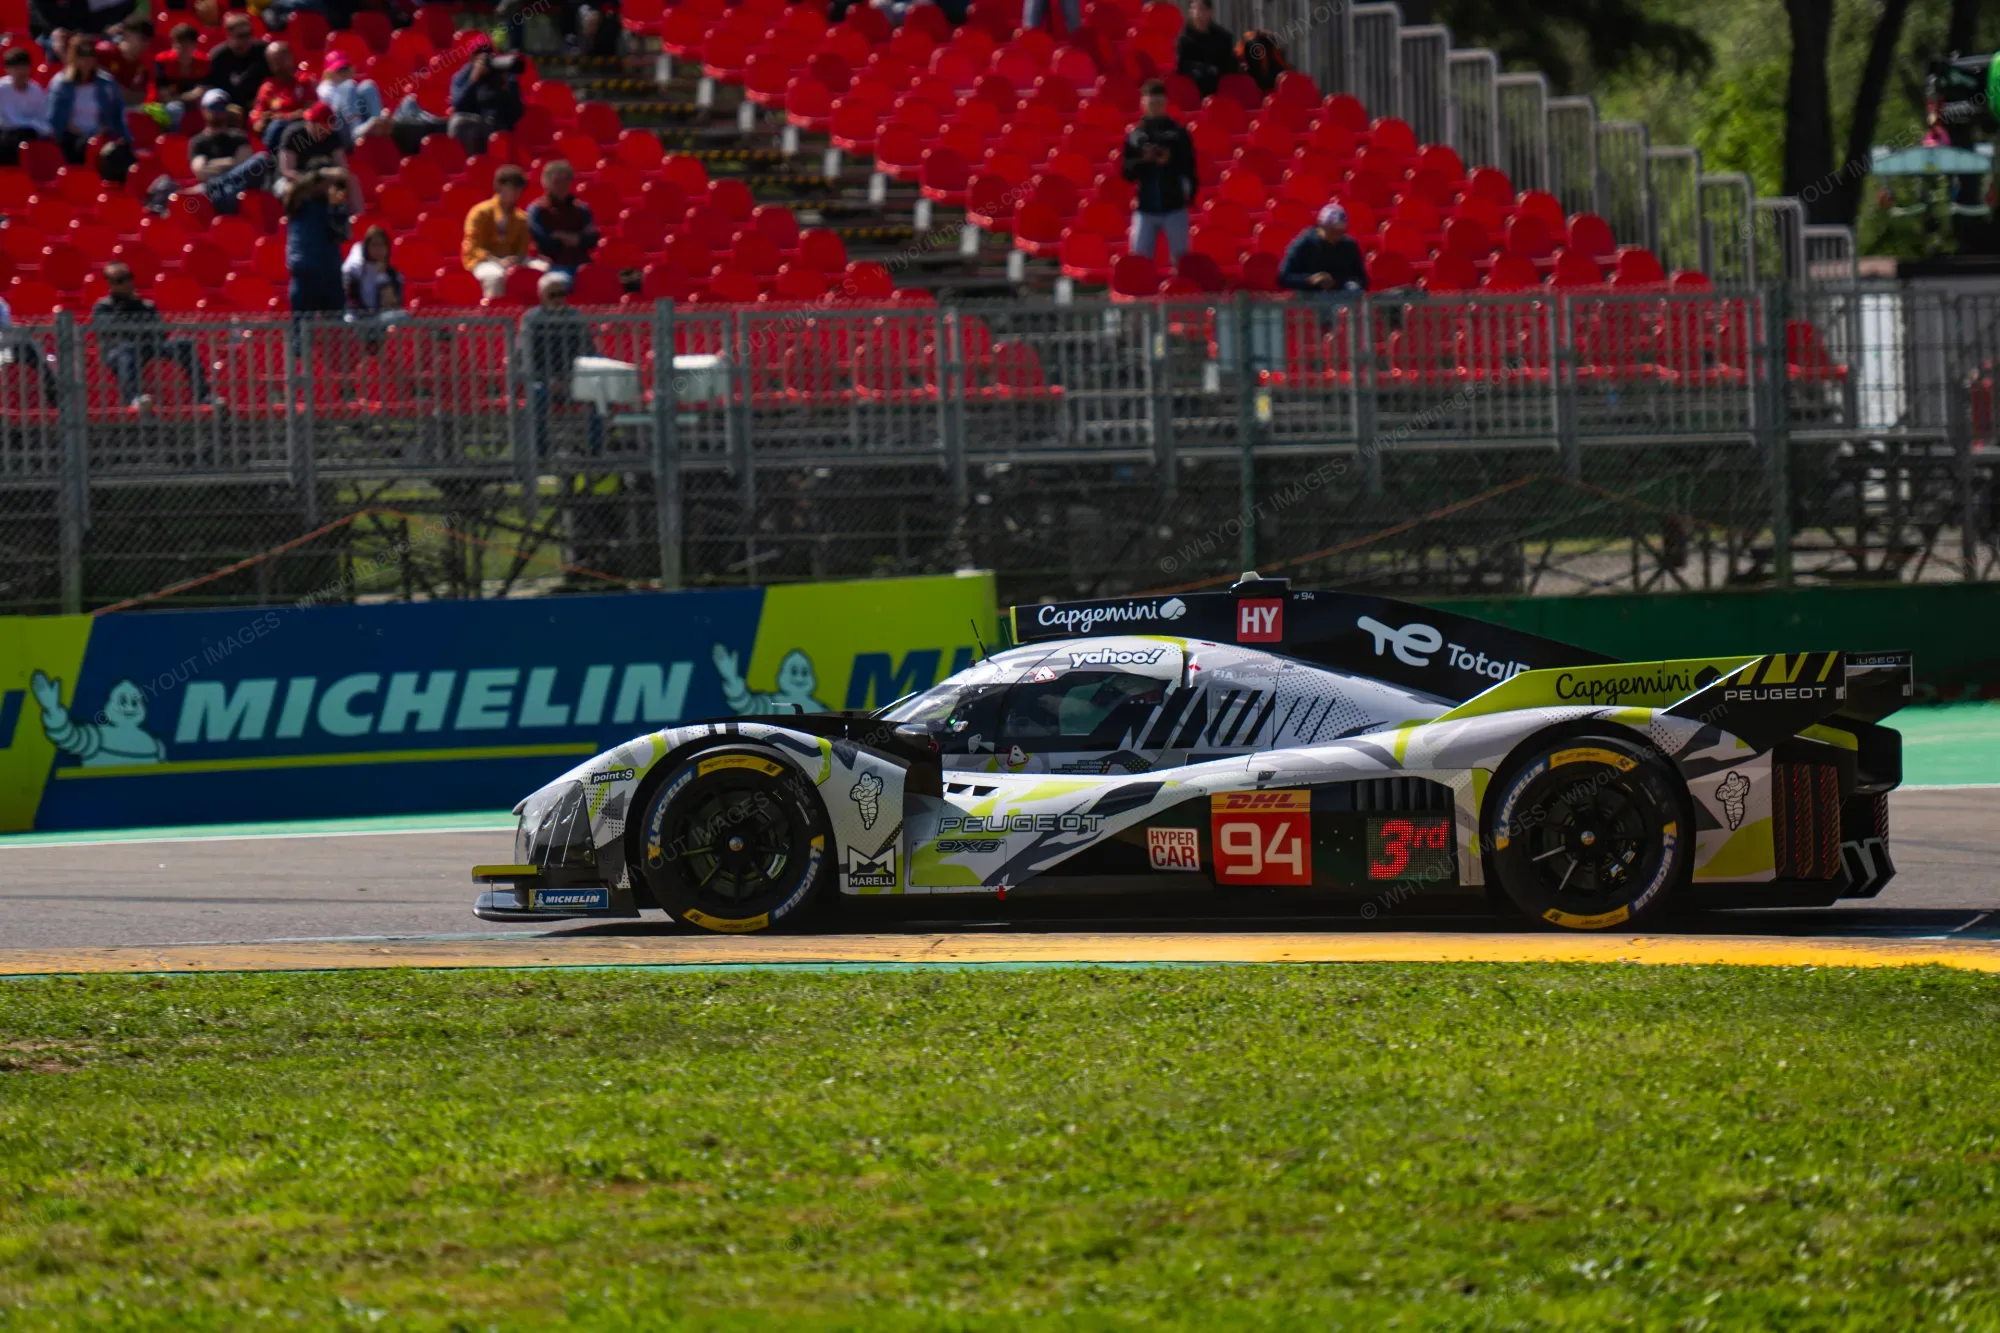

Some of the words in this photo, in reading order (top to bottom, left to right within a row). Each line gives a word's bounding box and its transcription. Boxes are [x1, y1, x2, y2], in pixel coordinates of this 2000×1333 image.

[1038, 601, 1158, 633] Capgemini
[1240, 606, 1279, 634] HY
[1069, 648, 1166, 668] yahoo!
[1556, 669, 1692, 705] Capgemini
[1725, 687, 1827, 701] PEUGEOT
[174, 661, 693, 742] MICHELIN
[651, 770, 693, 833] MICHELIN
[1225, 793, 1297, 809] DHL
[939, 814, 1105, 834] PEUGEOT
[1150, 830, 1195, 846] HYPER
[1220, 822, 1303, 875] 94
[1370, 818, 1450, 879] 3rd
[1152, 846, 1197, 867] CAR
[850, 877, 895, 885] MARELLI
[545, 895, 600, 904] MICHELIN
